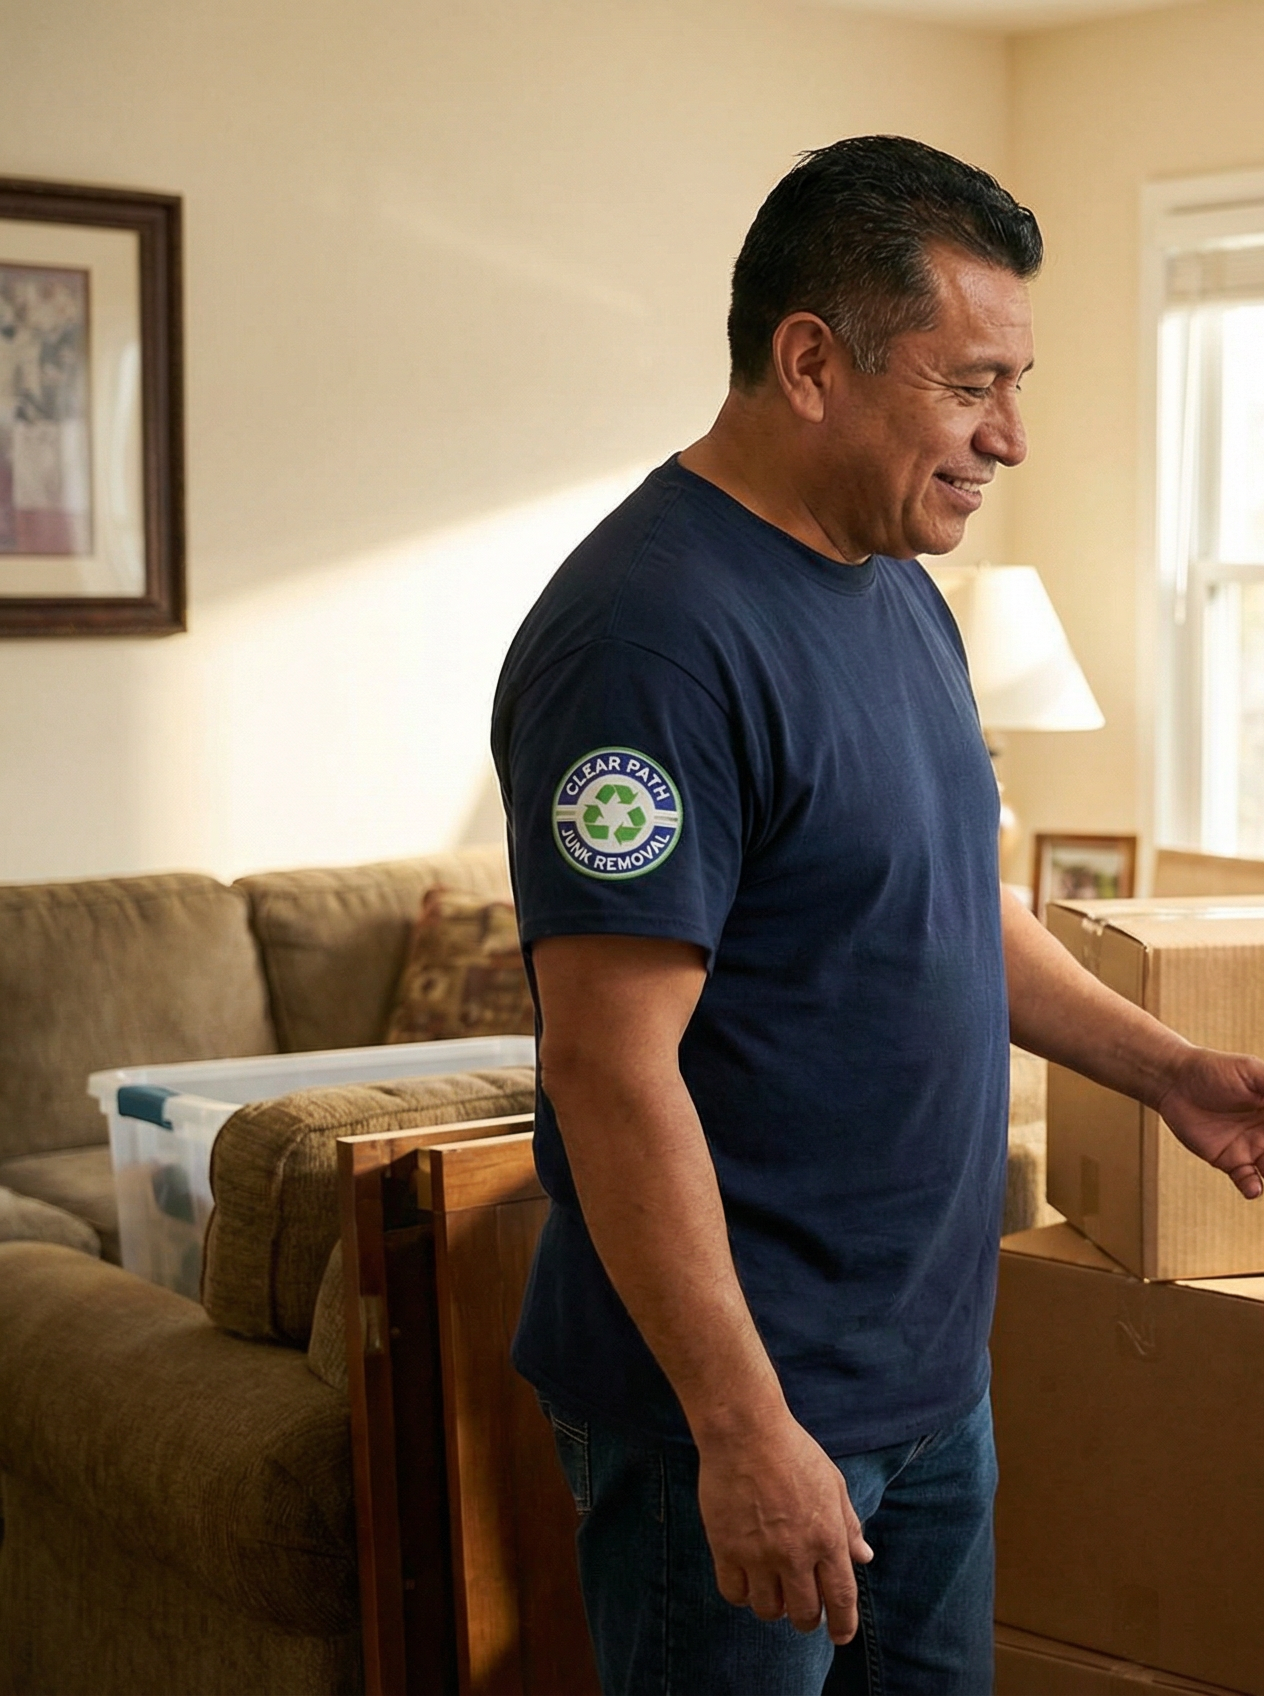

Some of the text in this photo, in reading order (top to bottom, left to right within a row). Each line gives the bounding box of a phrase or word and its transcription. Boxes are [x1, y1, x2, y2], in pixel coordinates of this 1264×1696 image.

[566, 756, 671, 801] CLEAR PATH
[561, 829, 671, 871] JUNK REMOVAL
